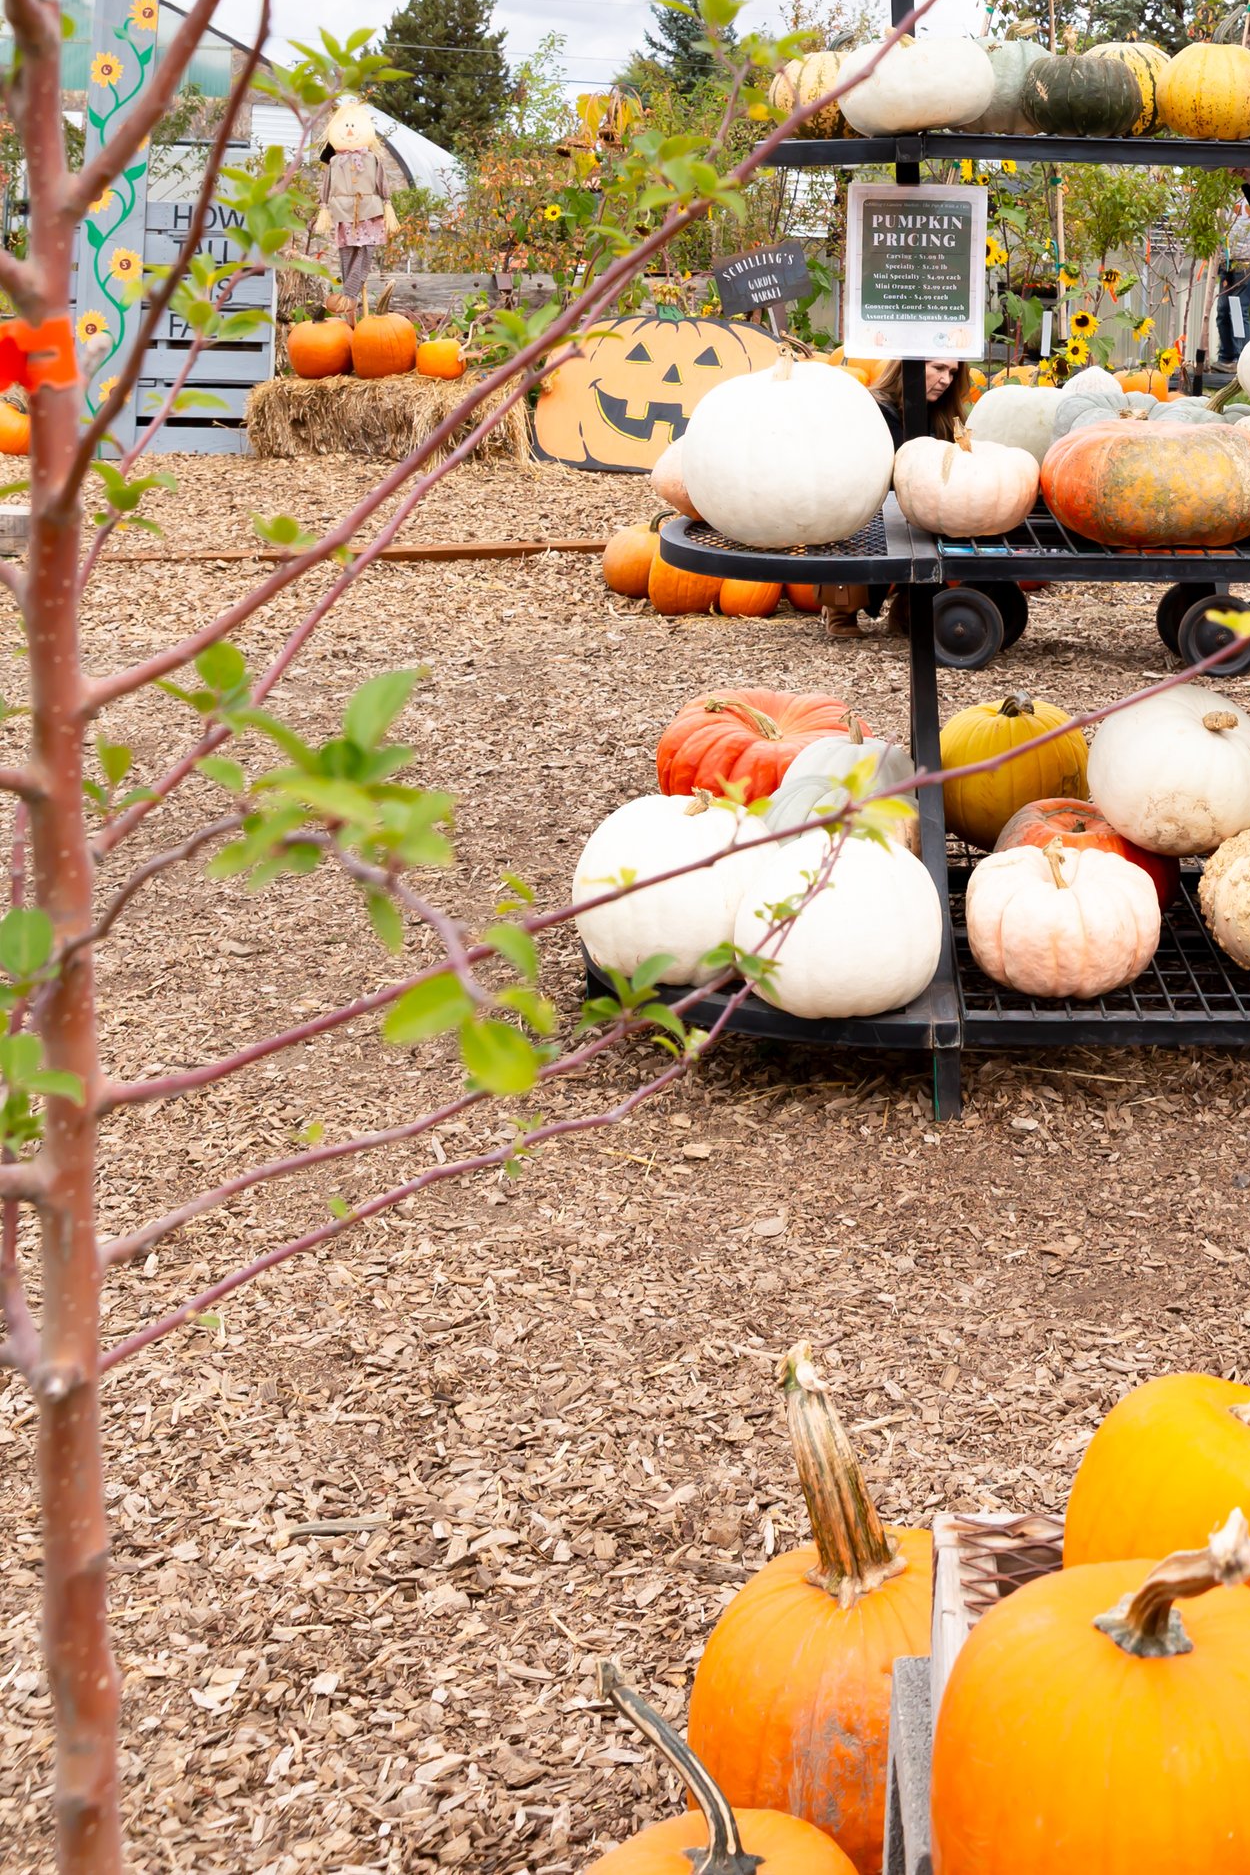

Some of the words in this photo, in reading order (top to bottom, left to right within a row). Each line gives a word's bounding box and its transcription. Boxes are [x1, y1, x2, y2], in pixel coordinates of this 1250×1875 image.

[872, 214, 963, 229] PUMPKIN
[872, 233, 956, 247] PRICING
[722, 252, 794, 282] SCHILLING'S
[748, 274, 778, 290] GARDEN
[751, 286, 782, 303] MARKET
